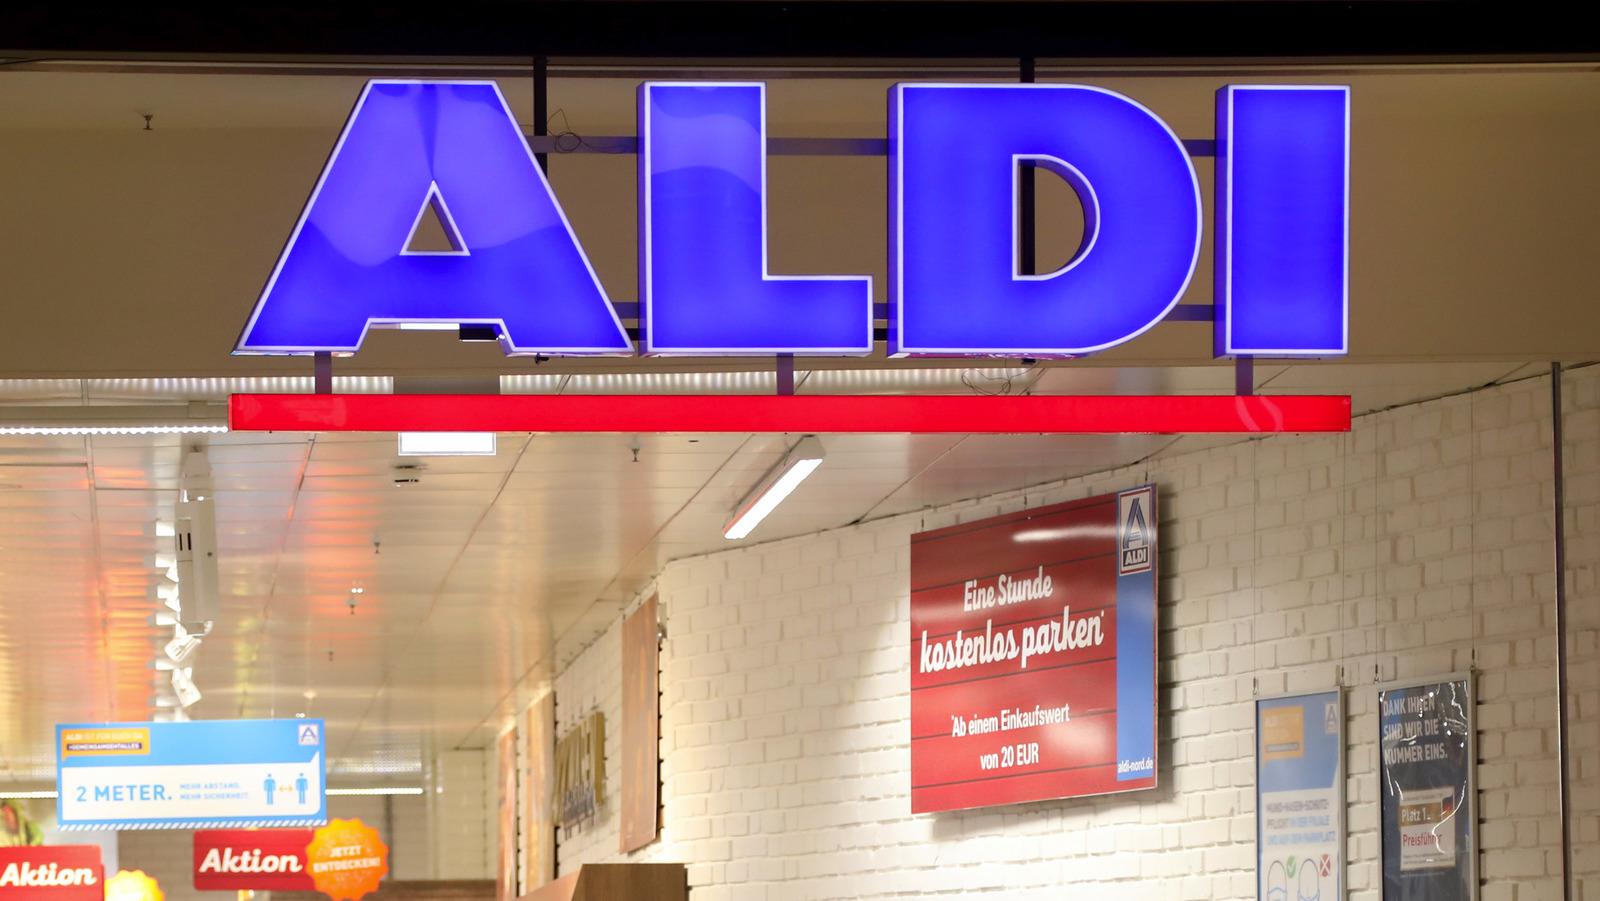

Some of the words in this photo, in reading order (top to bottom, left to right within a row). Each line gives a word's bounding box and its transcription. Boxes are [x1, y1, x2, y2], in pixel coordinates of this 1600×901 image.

[231, 79, 1351, 358] ALDI
[1124, 548, 1147, 567] ALDI
[963, 578, 996, 612] Eine
[997, 565, 1054, 606] Stunde
[919, 619, 1020, 673] kostenlos
[1383, 697, 1406, 716] DANK
[1407, 695, 1436, 713] IHNEN
[968, 714, 998, 736] einem
[1001, 703, 1070, 732] Einkaufswert
[1383, 723, 1404, 741] SIND
[1405, 720, 1423, 738] WIR
[1424, 718, 1440, 736] DIE
[980, 751, 999, 770] von
[1000, 745, 1014, 768] 20
[1016, 742, 1039, 765] EUR
[1117, 756, 1154, 774] aldi-nord.de
[1384, 744, 1423, 766] NUMMER
[1424, 742, 1448, 761] EINS.
[76, 785, 87, 802] 2
[94, 784, 173, 802] METER.
[1401, 808, 1421, 823] Platz
[1402, 831, 1443, 847] Preisführr
[199, 847, 303, 874] Aktion
[329, 845, 361, 858] JETZT
[0, 861, 98, 888] Aktion
[313, 856, 381, 873] ENTDECKEN!
